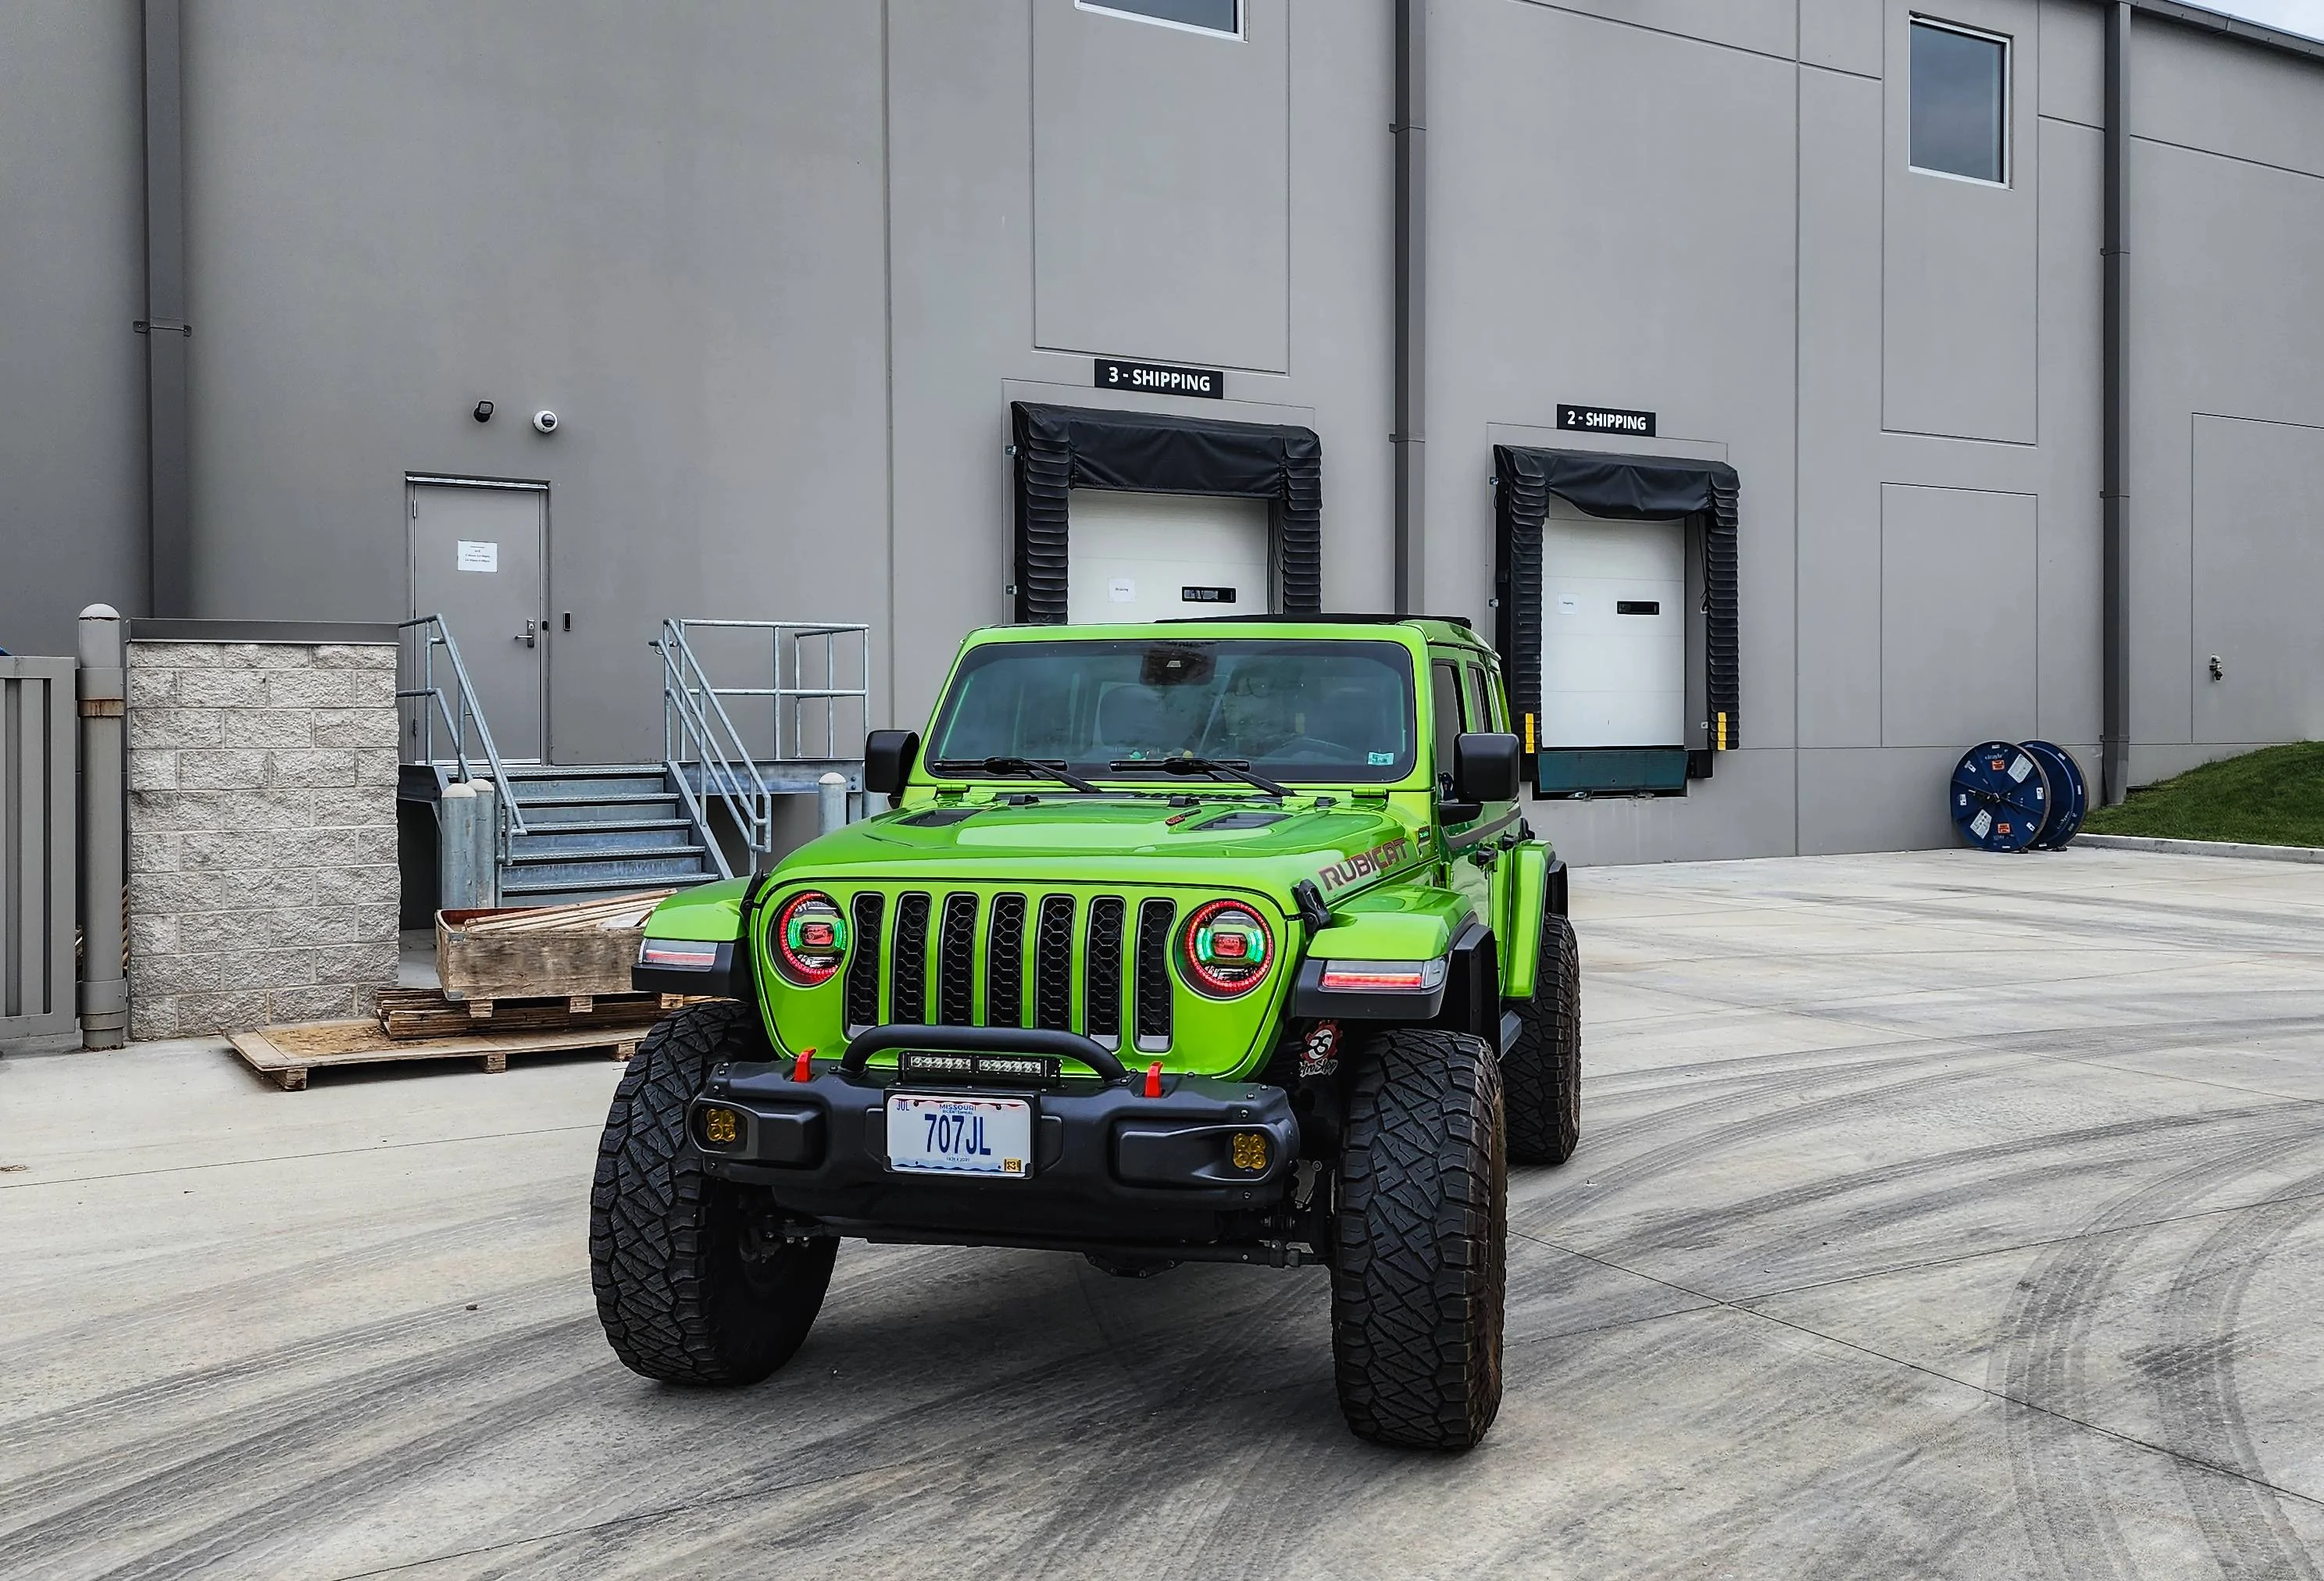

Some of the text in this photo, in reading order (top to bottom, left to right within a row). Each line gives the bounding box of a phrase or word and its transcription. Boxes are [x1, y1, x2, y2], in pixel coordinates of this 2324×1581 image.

[1109, 367, 1119, 383] 3
[1133, 369, 1210, 391] SHIPPING
[1568, 410, 1576, 425] 2
[1587, 412, 1647, 430] SHIPPING
[1318, 837, 1408, 891] RUBICAT
[897, 1101, 910, 1112] JUL
[1007, 1161, 1016, 1170] 23
